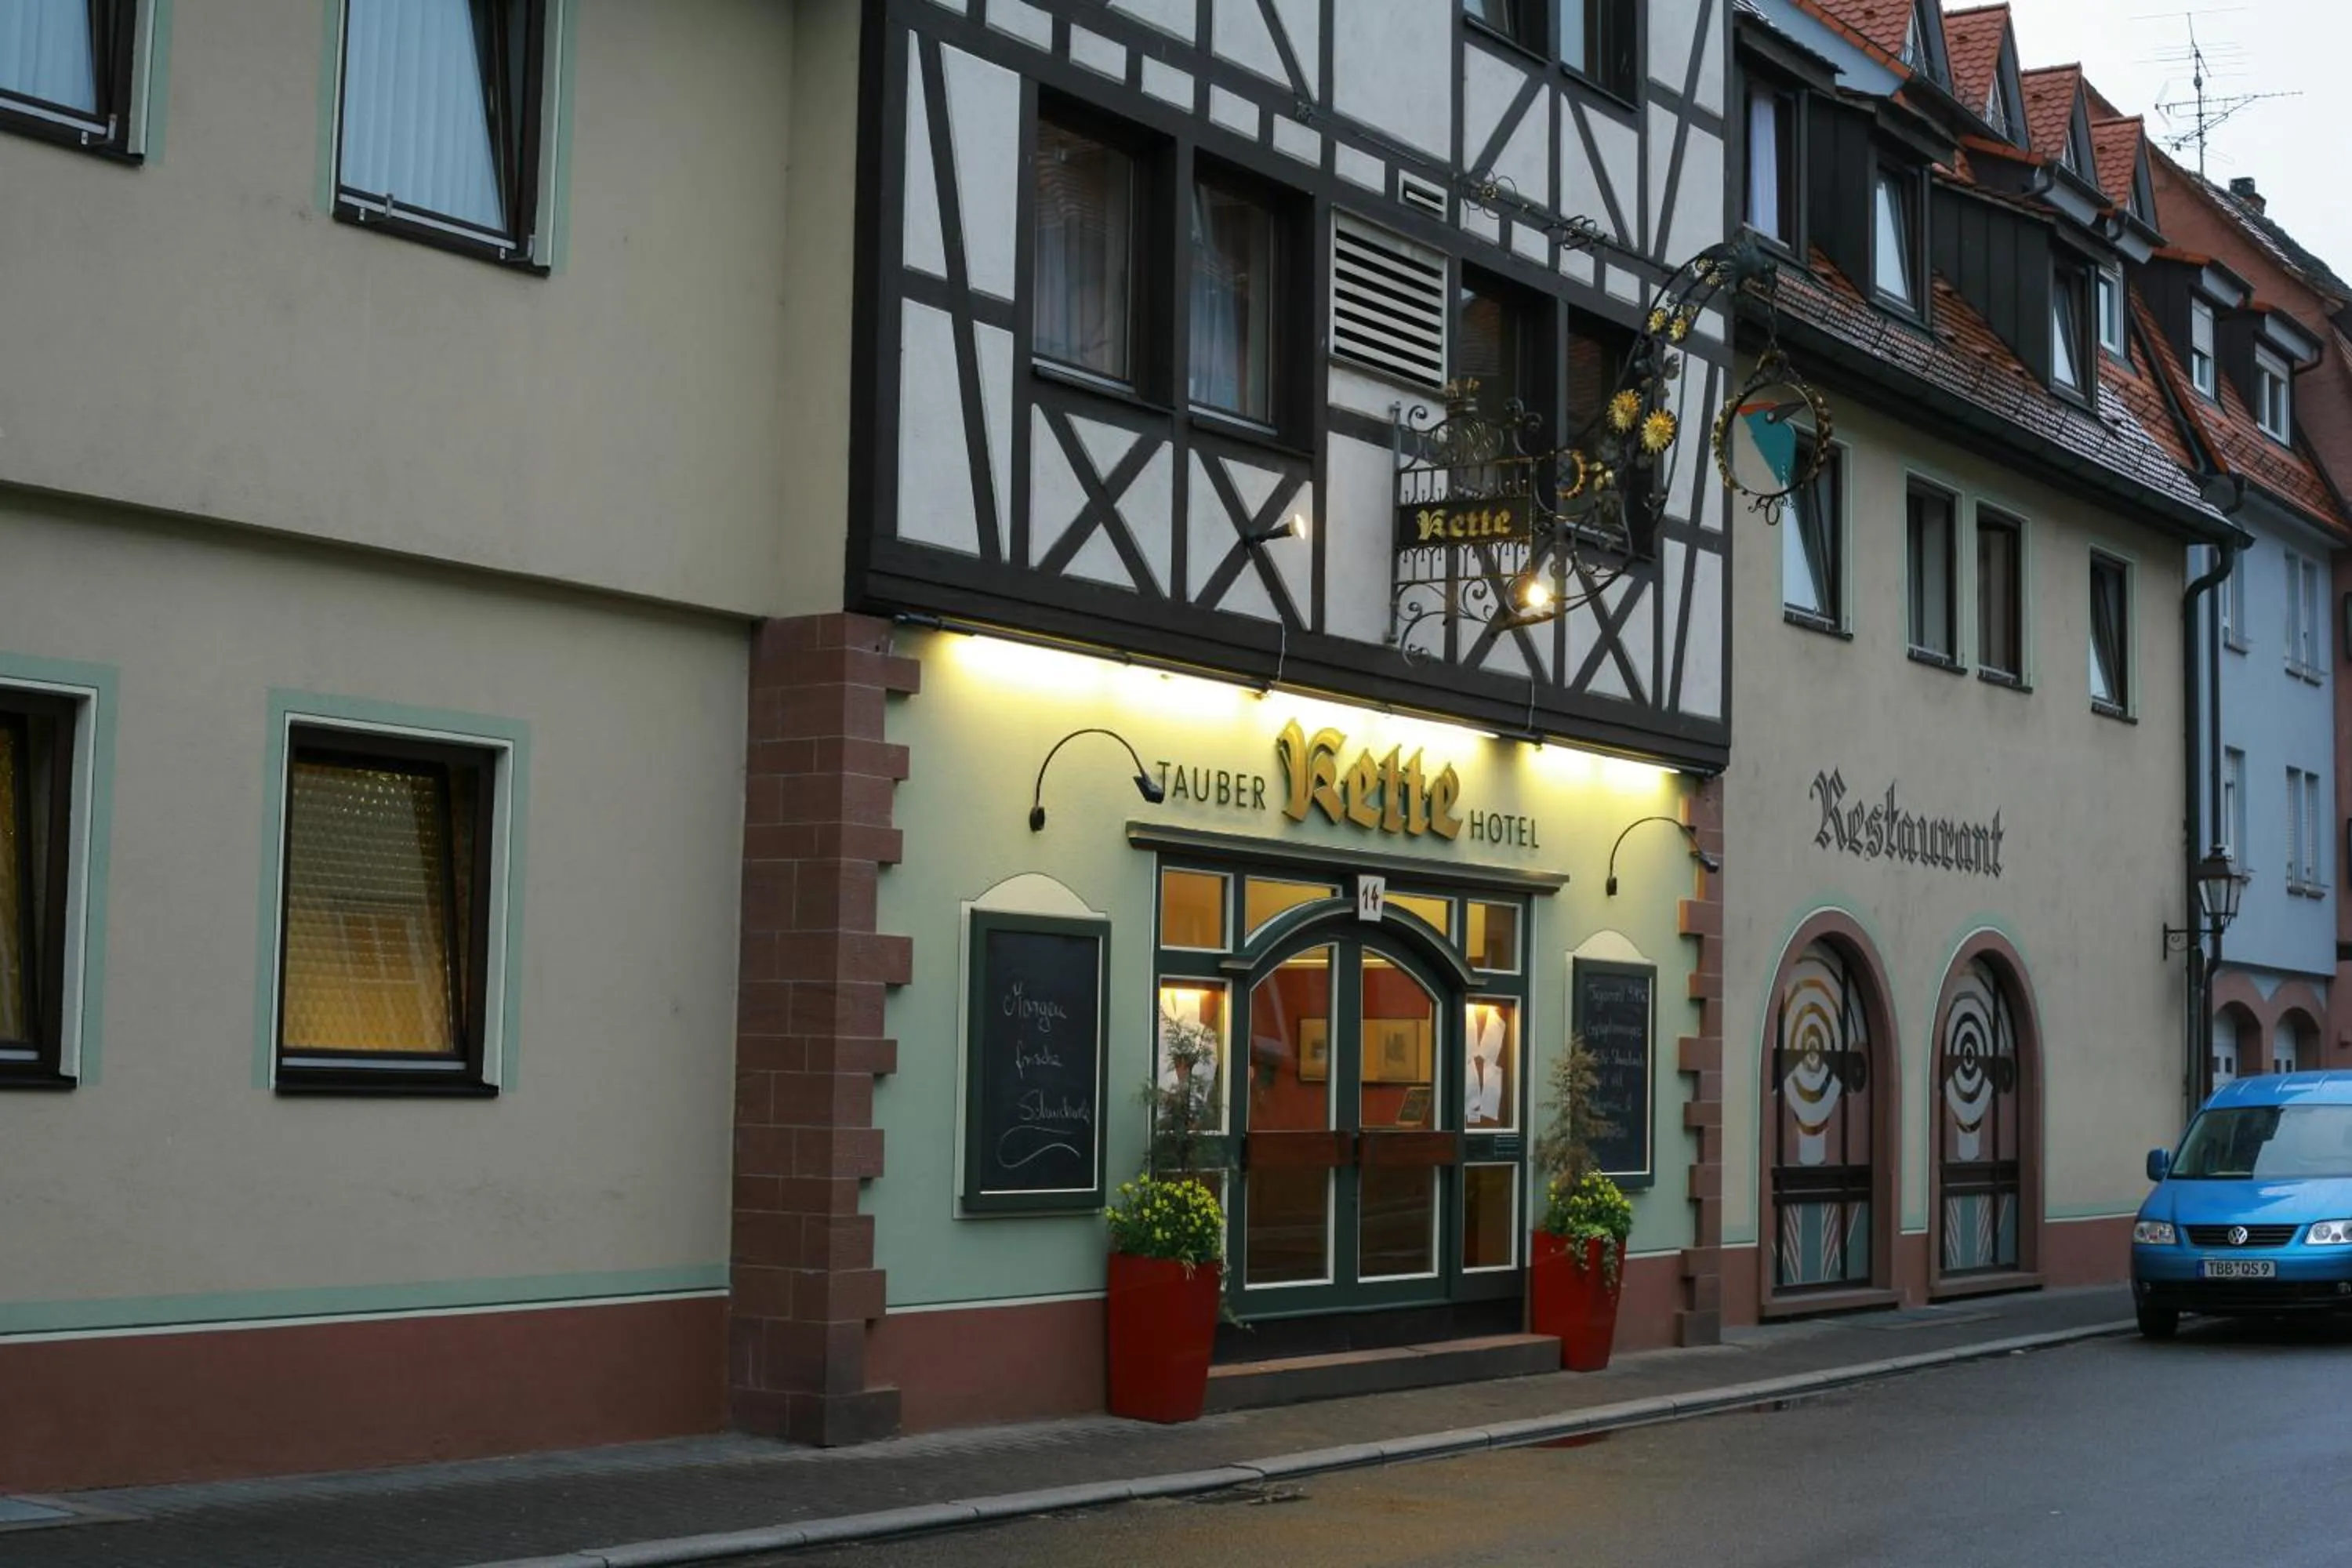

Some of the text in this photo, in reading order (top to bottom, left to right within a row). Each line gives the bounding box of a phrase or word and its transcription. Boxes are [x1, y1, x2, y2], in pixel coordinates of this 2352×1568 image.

[1417, 509, 1512, 541] Kette
[1156, 716, 1540, 848] TAUBER Kette HOTEL
[1809, 764, 2005, 878] Restaurant
[1362, 883, 1380, 911] 14
[2207, 1261, 2234, 1276] TBB
